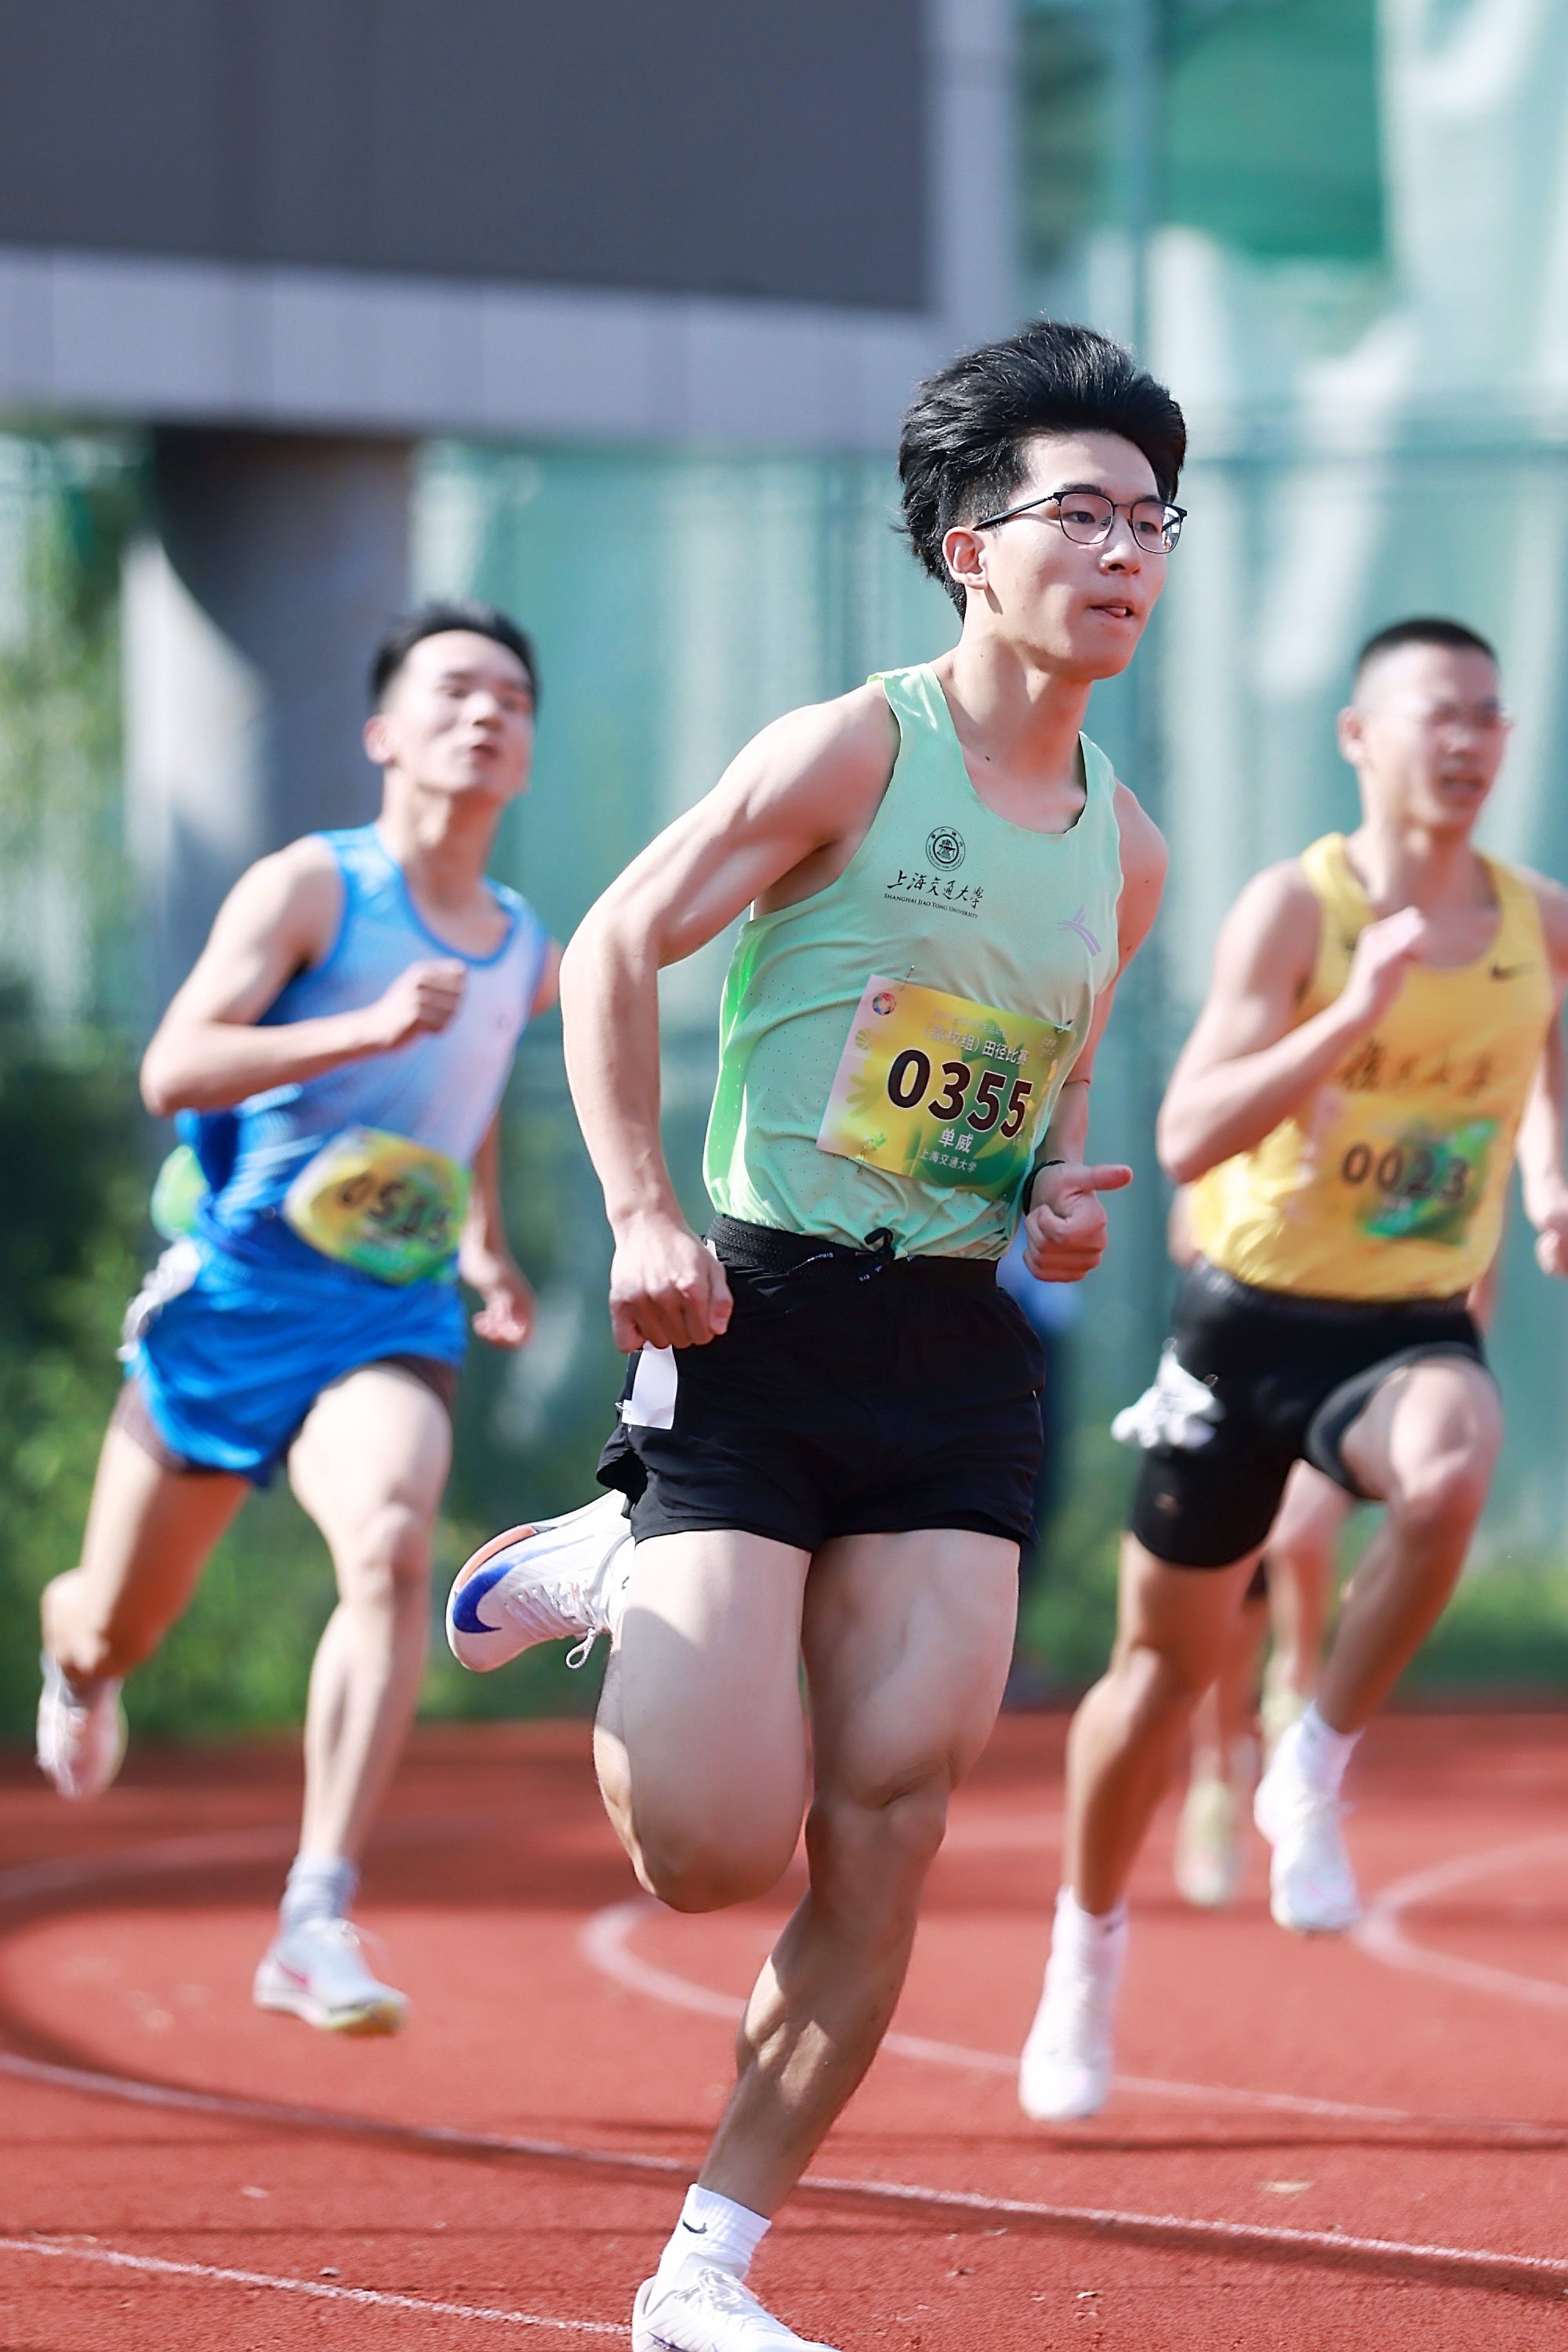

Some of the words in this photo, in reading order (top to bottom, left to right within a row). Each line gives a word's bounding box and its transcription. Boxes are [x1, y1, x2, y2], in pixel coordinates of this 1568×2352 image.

[884, 893, 916, 904] SHANGHAI
[917, 898, 931, 907] JIAO
[931, 902, 948, 910] TONG
[887, 1049, 1033, 1139] 0355
[938, 1127, 975, 1154] 单威
[919, 1149, 978, 1174] 上海交通大学
